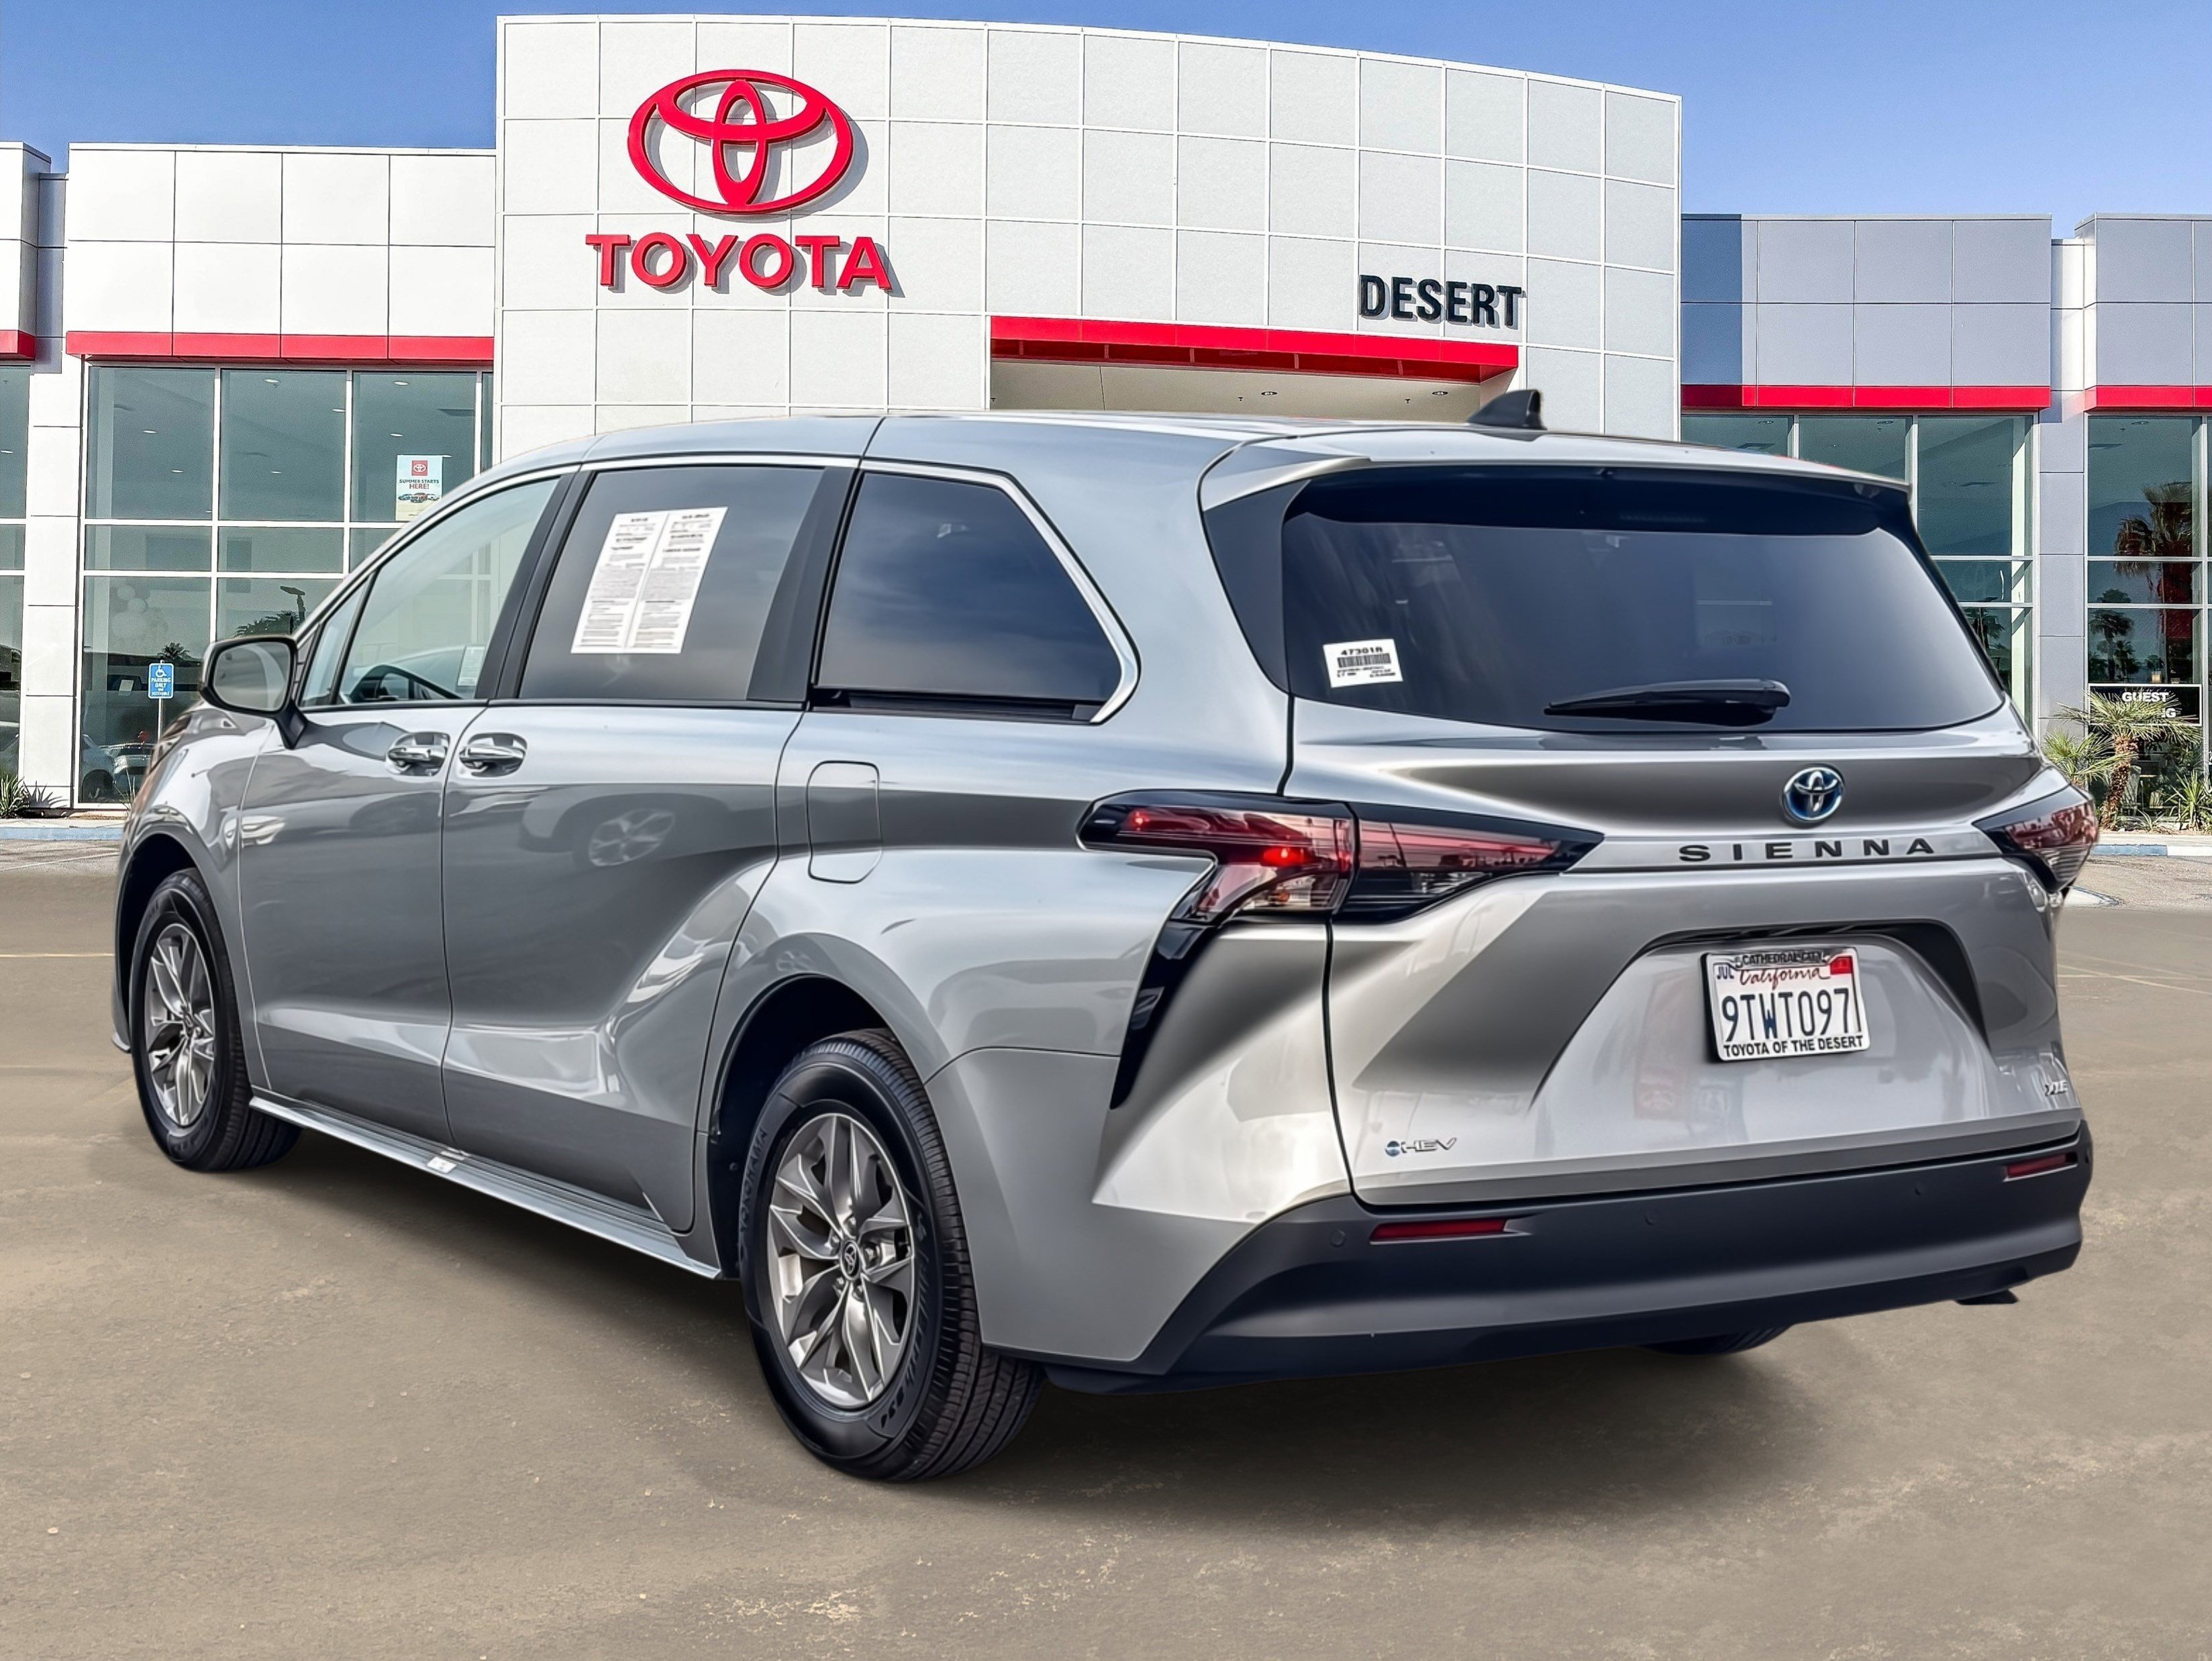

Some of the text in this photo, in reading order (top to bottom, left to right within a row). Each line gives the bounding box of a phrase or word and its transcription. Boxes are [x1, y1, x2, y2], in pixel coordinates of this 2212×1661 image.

[585, 232, 893, 290] TOYOTA
[1359, 274, 1522, 326] DESERT
[2122, 691, 2169, 703] GUEST
[1678, 838, 1935, 862] SIENNA
[1717, 966, 1735, 979] JUL
[1740, 967, 1831, 991] California
[1721, 987, 1849, 1042] 9TWT097
[1723, 1036, 1863, 1058] TOYOTA OF THE DESERT
